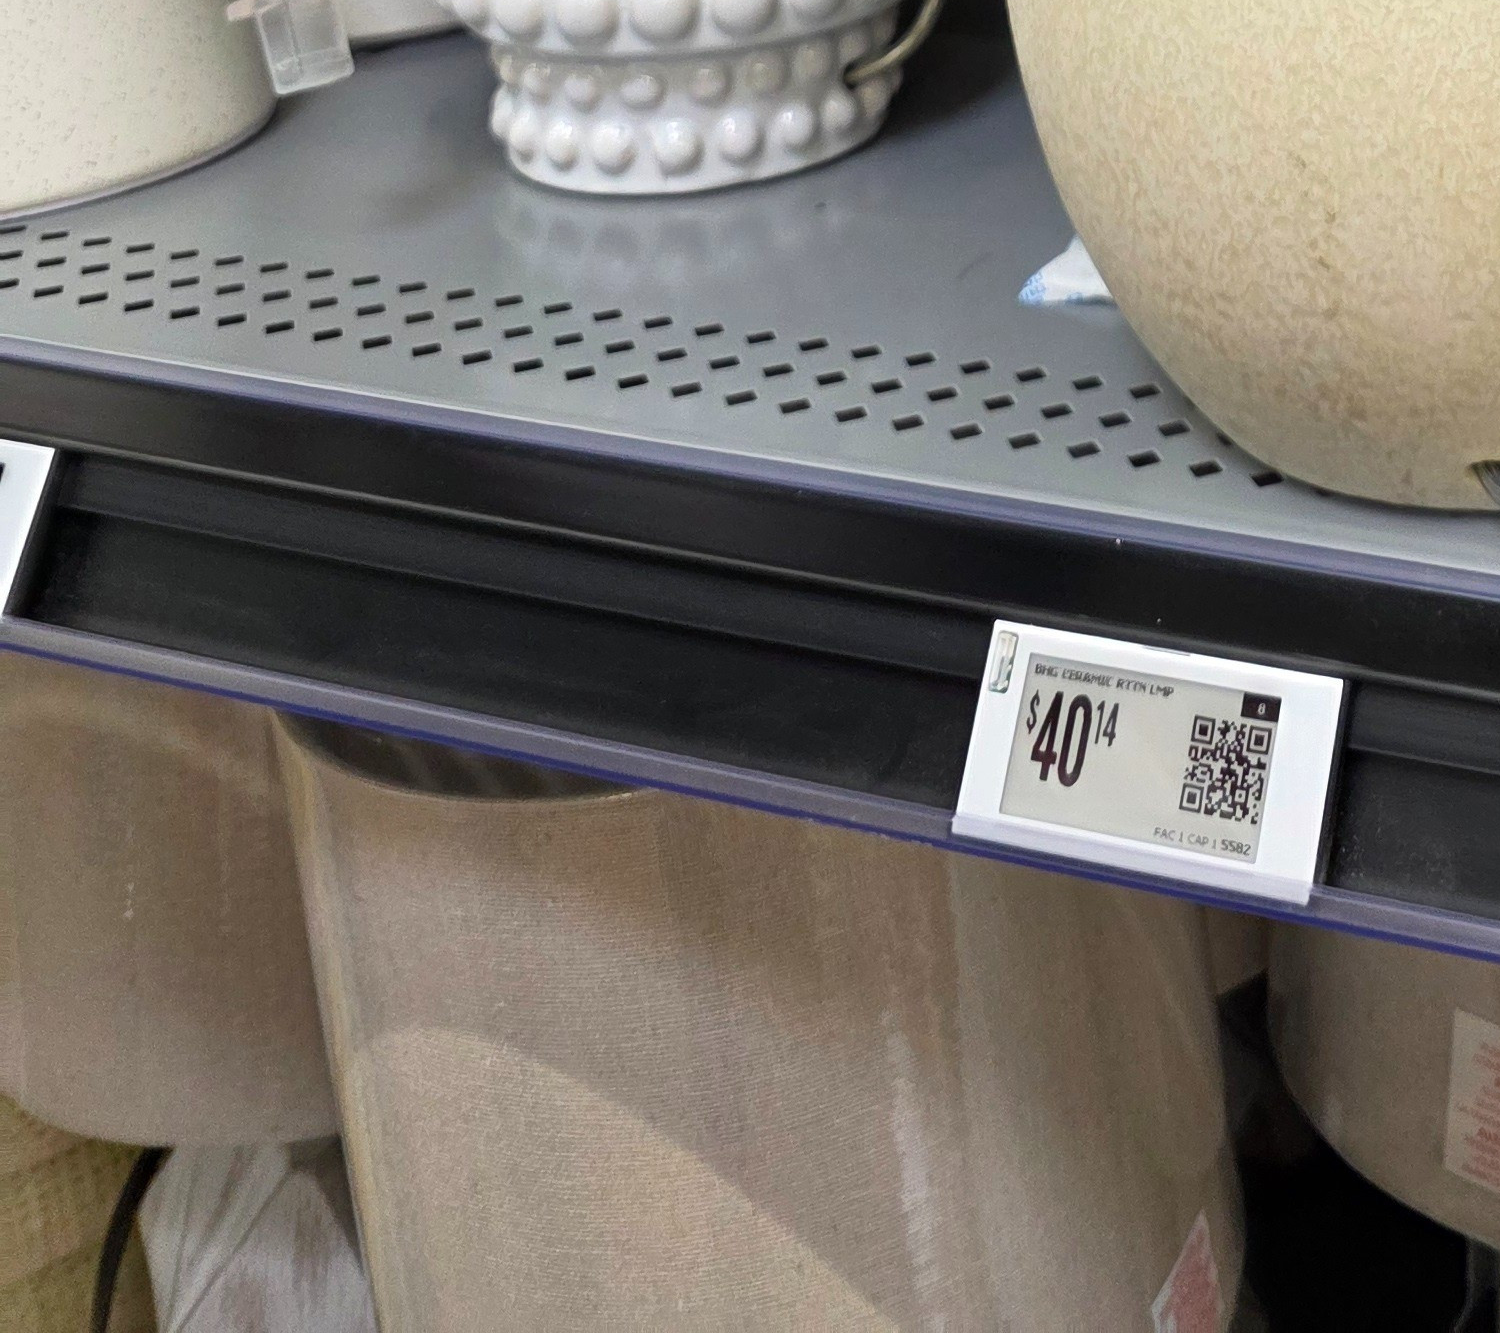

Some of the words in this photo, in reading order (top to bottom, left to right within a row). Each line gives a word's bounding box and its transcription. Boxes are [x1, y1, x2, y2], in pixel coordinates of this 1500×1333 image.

[1034, 662, 1058, 678] BHG
[1149, 684, 1175, 698] LMP
[1154, 827, 1176, 841] FAC
[1187, 833, 1210, 847] CAP
[1220, 839, 1252, 856] 5582
